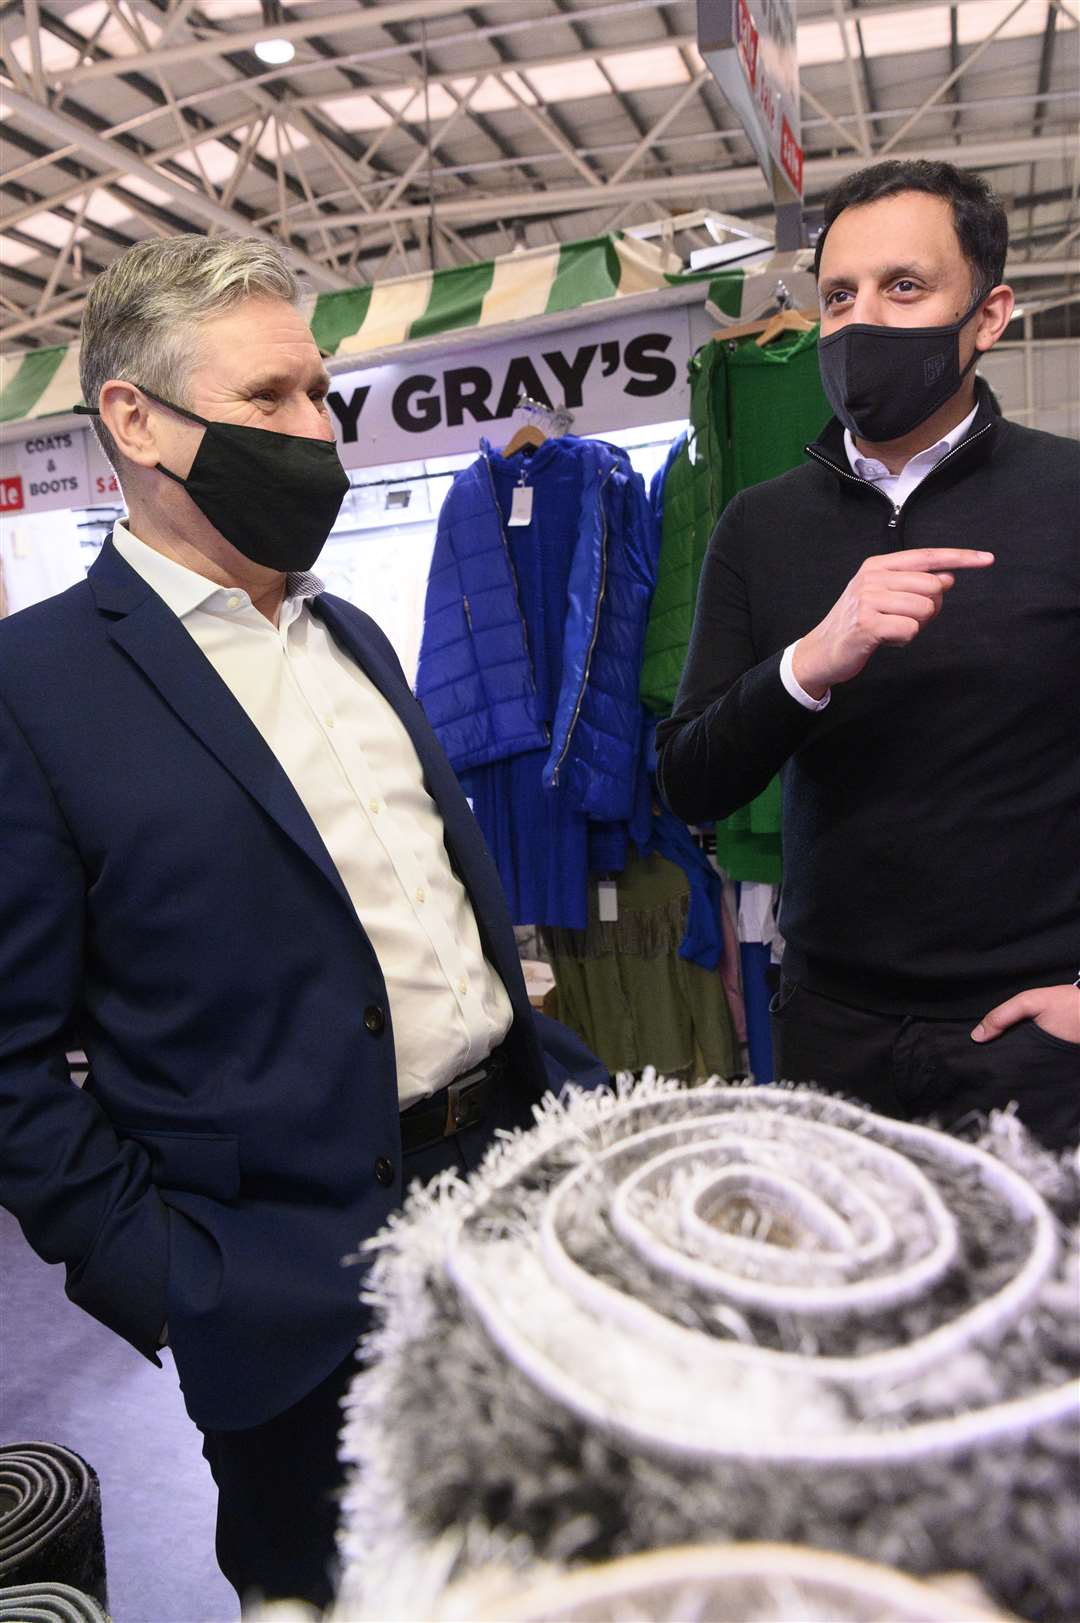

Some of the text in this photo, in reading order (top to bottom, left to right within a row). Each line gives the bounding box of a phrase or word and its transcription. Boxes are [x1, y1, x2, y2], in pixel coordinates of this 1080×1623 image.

[391, 333, 677, 433] GRAY'S
[25, 433, 73, 454] COATS
[47, 459, 56, 473] &
[29, 476, 78, 496] BOOTS
